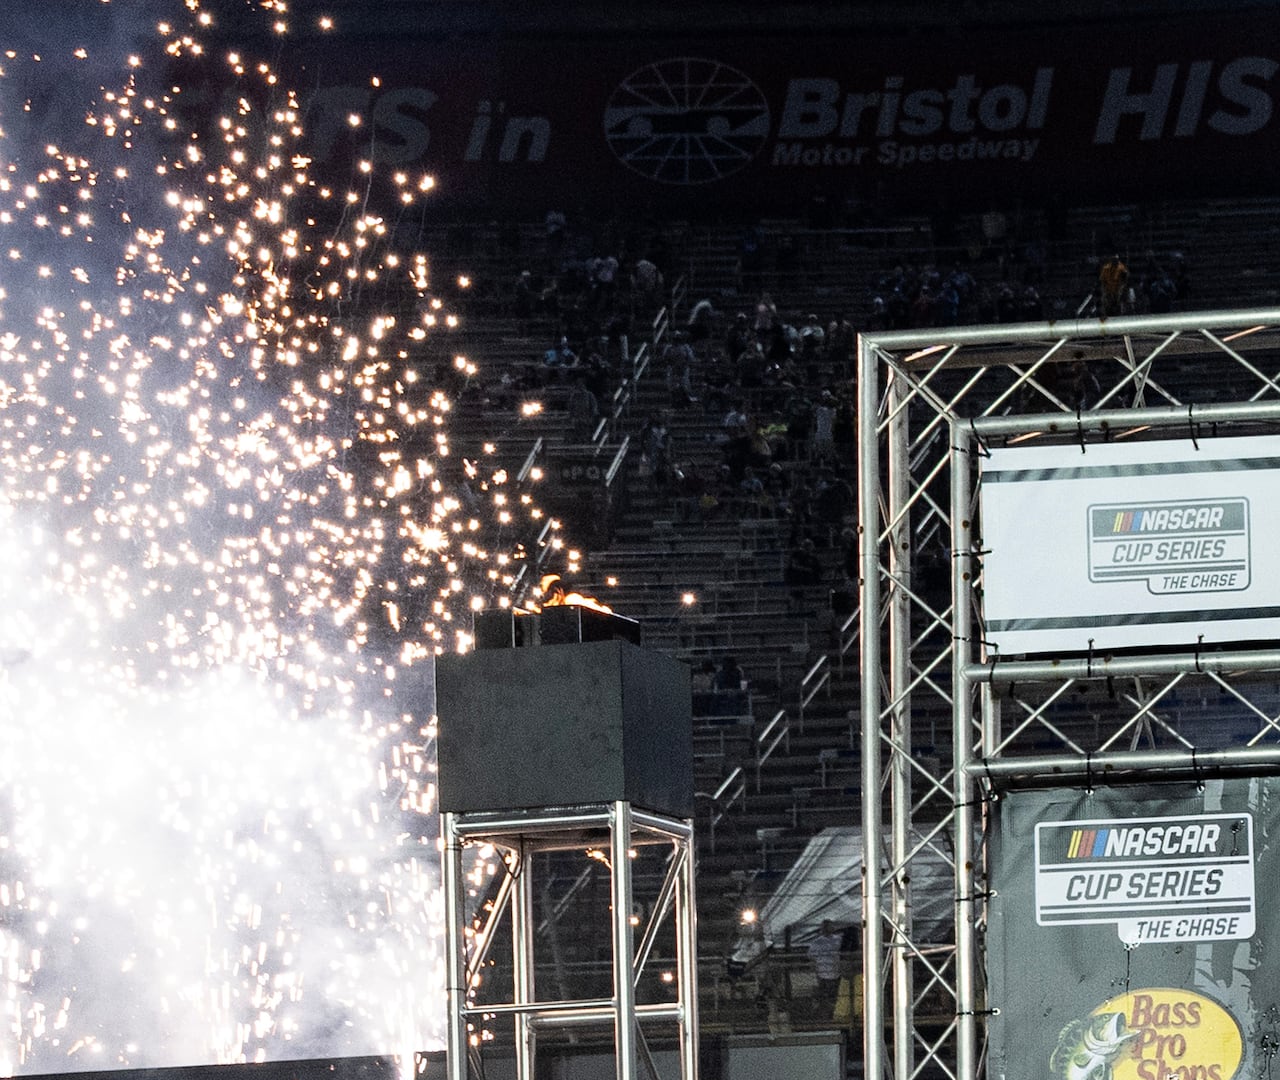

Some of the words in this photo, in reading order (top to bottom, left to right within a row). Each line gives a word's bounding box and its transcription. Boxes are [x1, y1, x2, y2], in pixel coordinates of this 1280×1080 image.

[464, 99, 552, 161] in
[780, 68, 1056, 140] Bristol
[774, 138, 868, 169] Motor
[877, 133, 1041, 173] Speedway
[1140, 506, 1224, 533] NASCAR
[1111, 542, 1158, 564] CUP
[1163, 537, 1226, 562] SERIES
[1162, 577, 1192, 591] THE
[1195, 573, 1237, 590] CHASE
[1103, 823, 1220, 858] NASCAR
[1066, 873, 1123, 901] CUP
[1126, 869, 1224, 898] SERIES
[1136, 919, 1173, 939] THE
[1175, 916, 1240, 937] CHASE
[1130, 994, 1202, 1028] Bass
[1137, 1028, 1187, 1062] Pro
